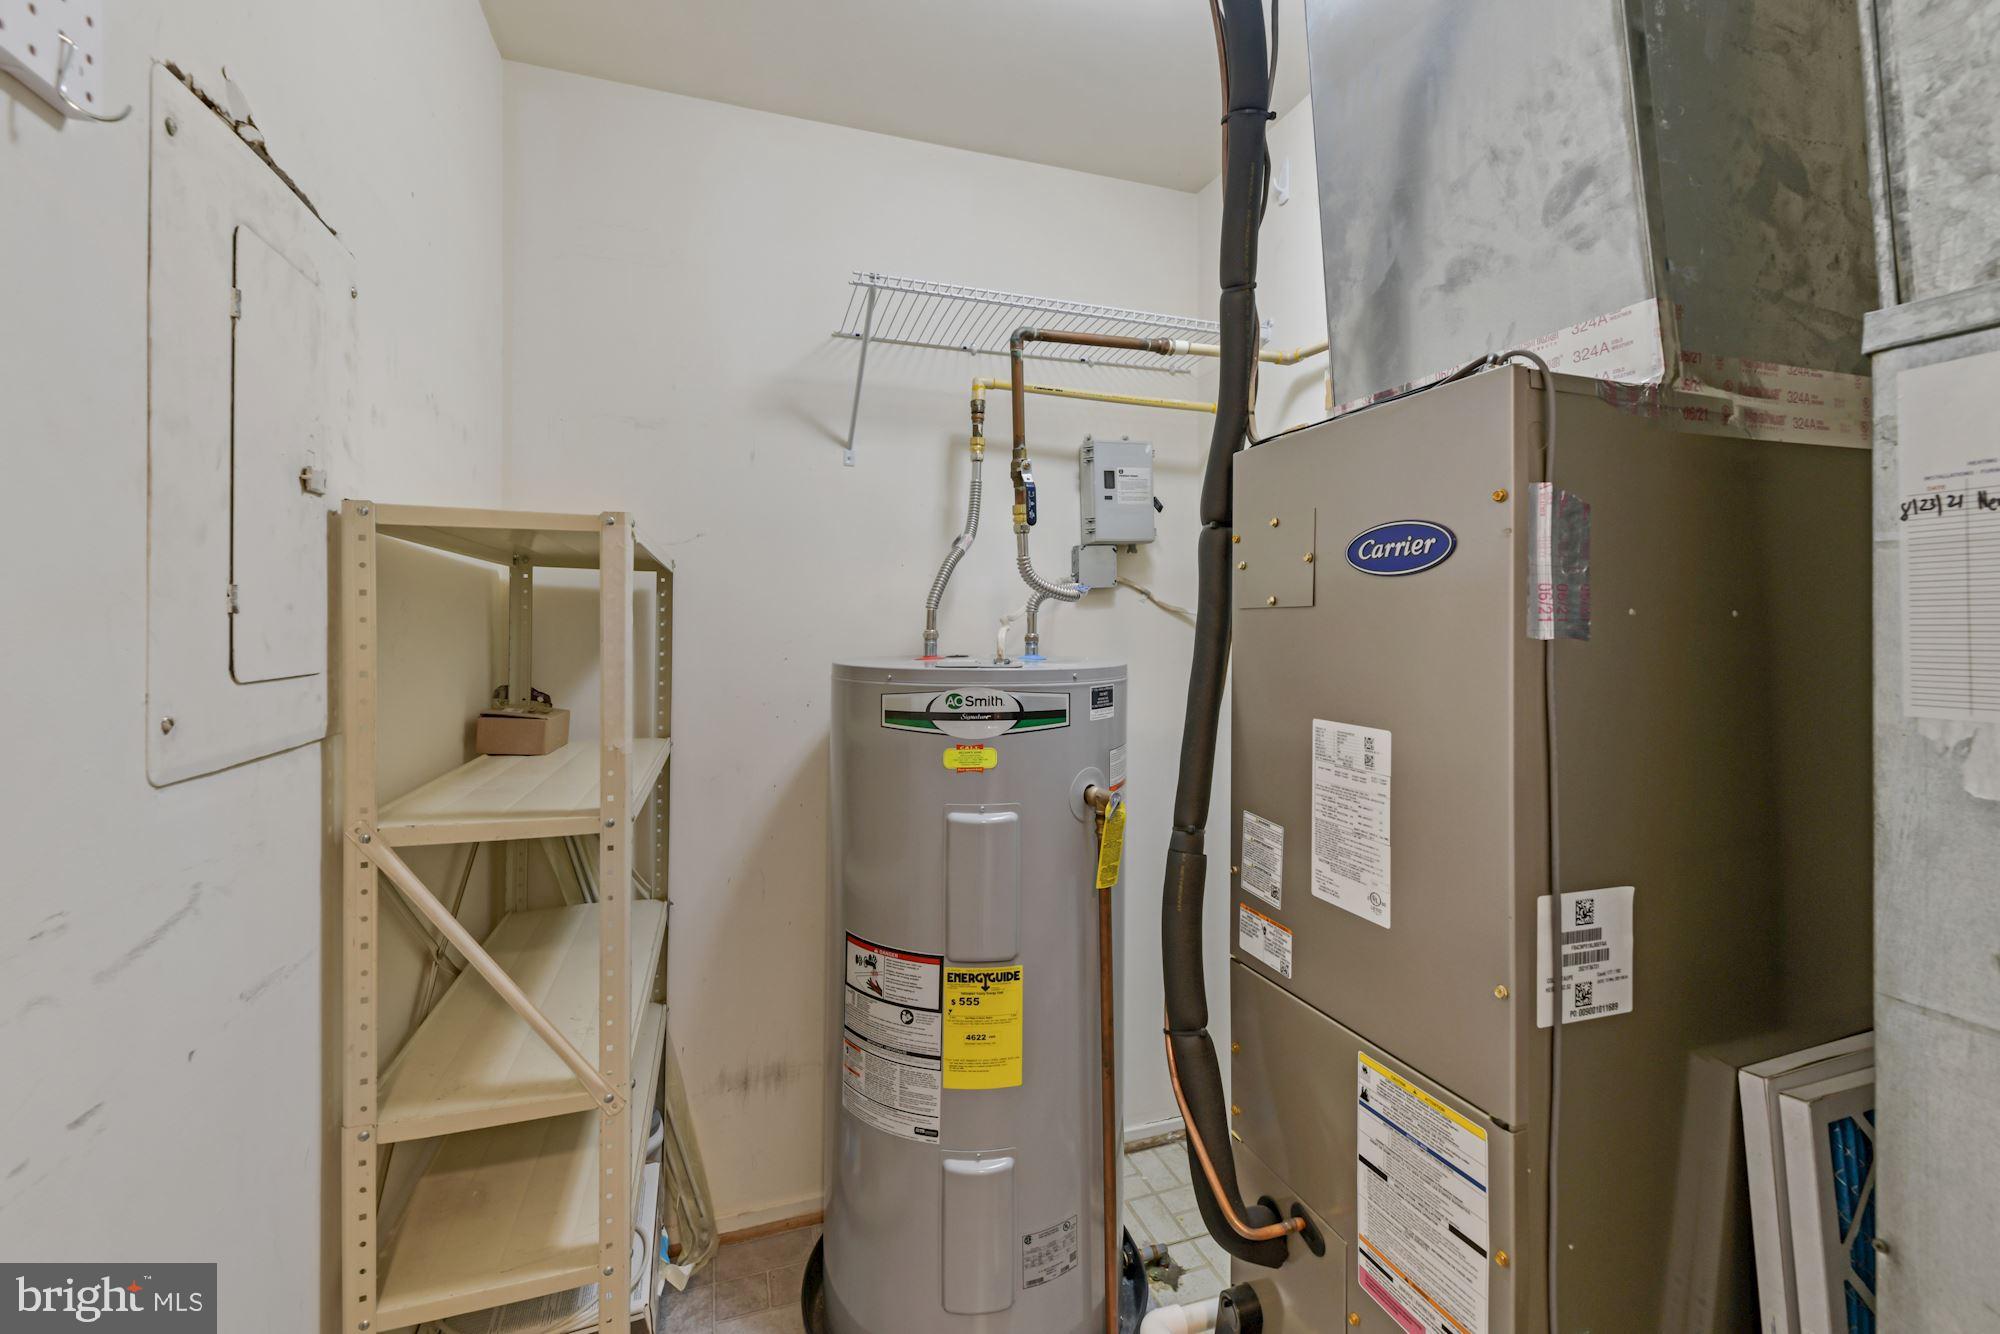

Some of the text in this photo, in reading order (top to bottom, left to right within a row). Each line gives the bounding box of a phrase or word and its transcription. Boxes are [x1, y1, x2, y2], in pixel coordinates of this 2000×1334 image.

[1573, 342, 1610, 364] 324A
[1358, 535, 1437, 560] Carrier
[1537, 583, 1553, 622] 06/21
[965, 695, 1003, 707] Smith
[947, 970, 1021, 985] ENERGYGUIDE
[959, 997, 980, 1006] 555
